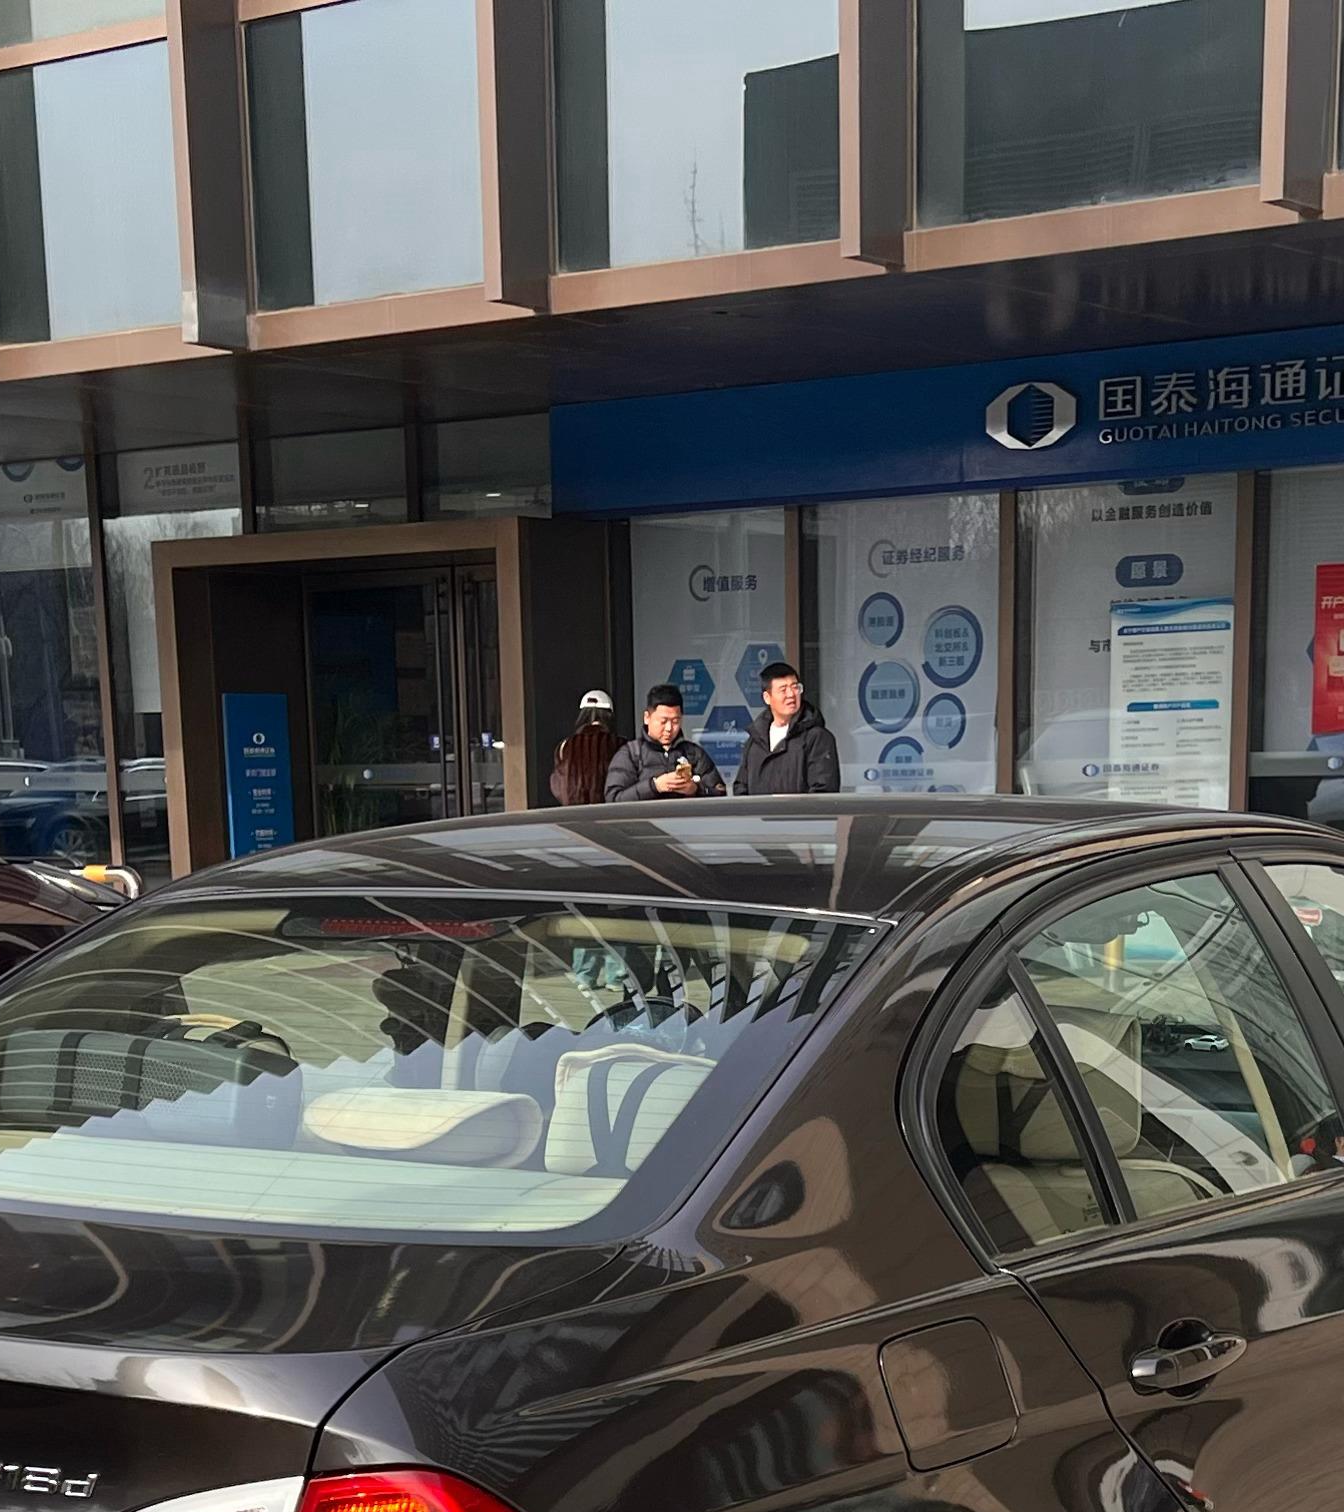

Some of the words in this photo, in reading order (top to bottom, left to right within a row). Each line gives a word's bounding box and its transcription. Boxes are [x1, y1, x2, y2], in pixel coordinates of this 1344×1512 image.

[1098, 423, 1177, 445] GUOTAI
[1184, 412, 1282, 438] HAITONG
[1091, 501, 1213, 523] 以金融服务创造价值
[703, 574, 758, 593] 增值服务
